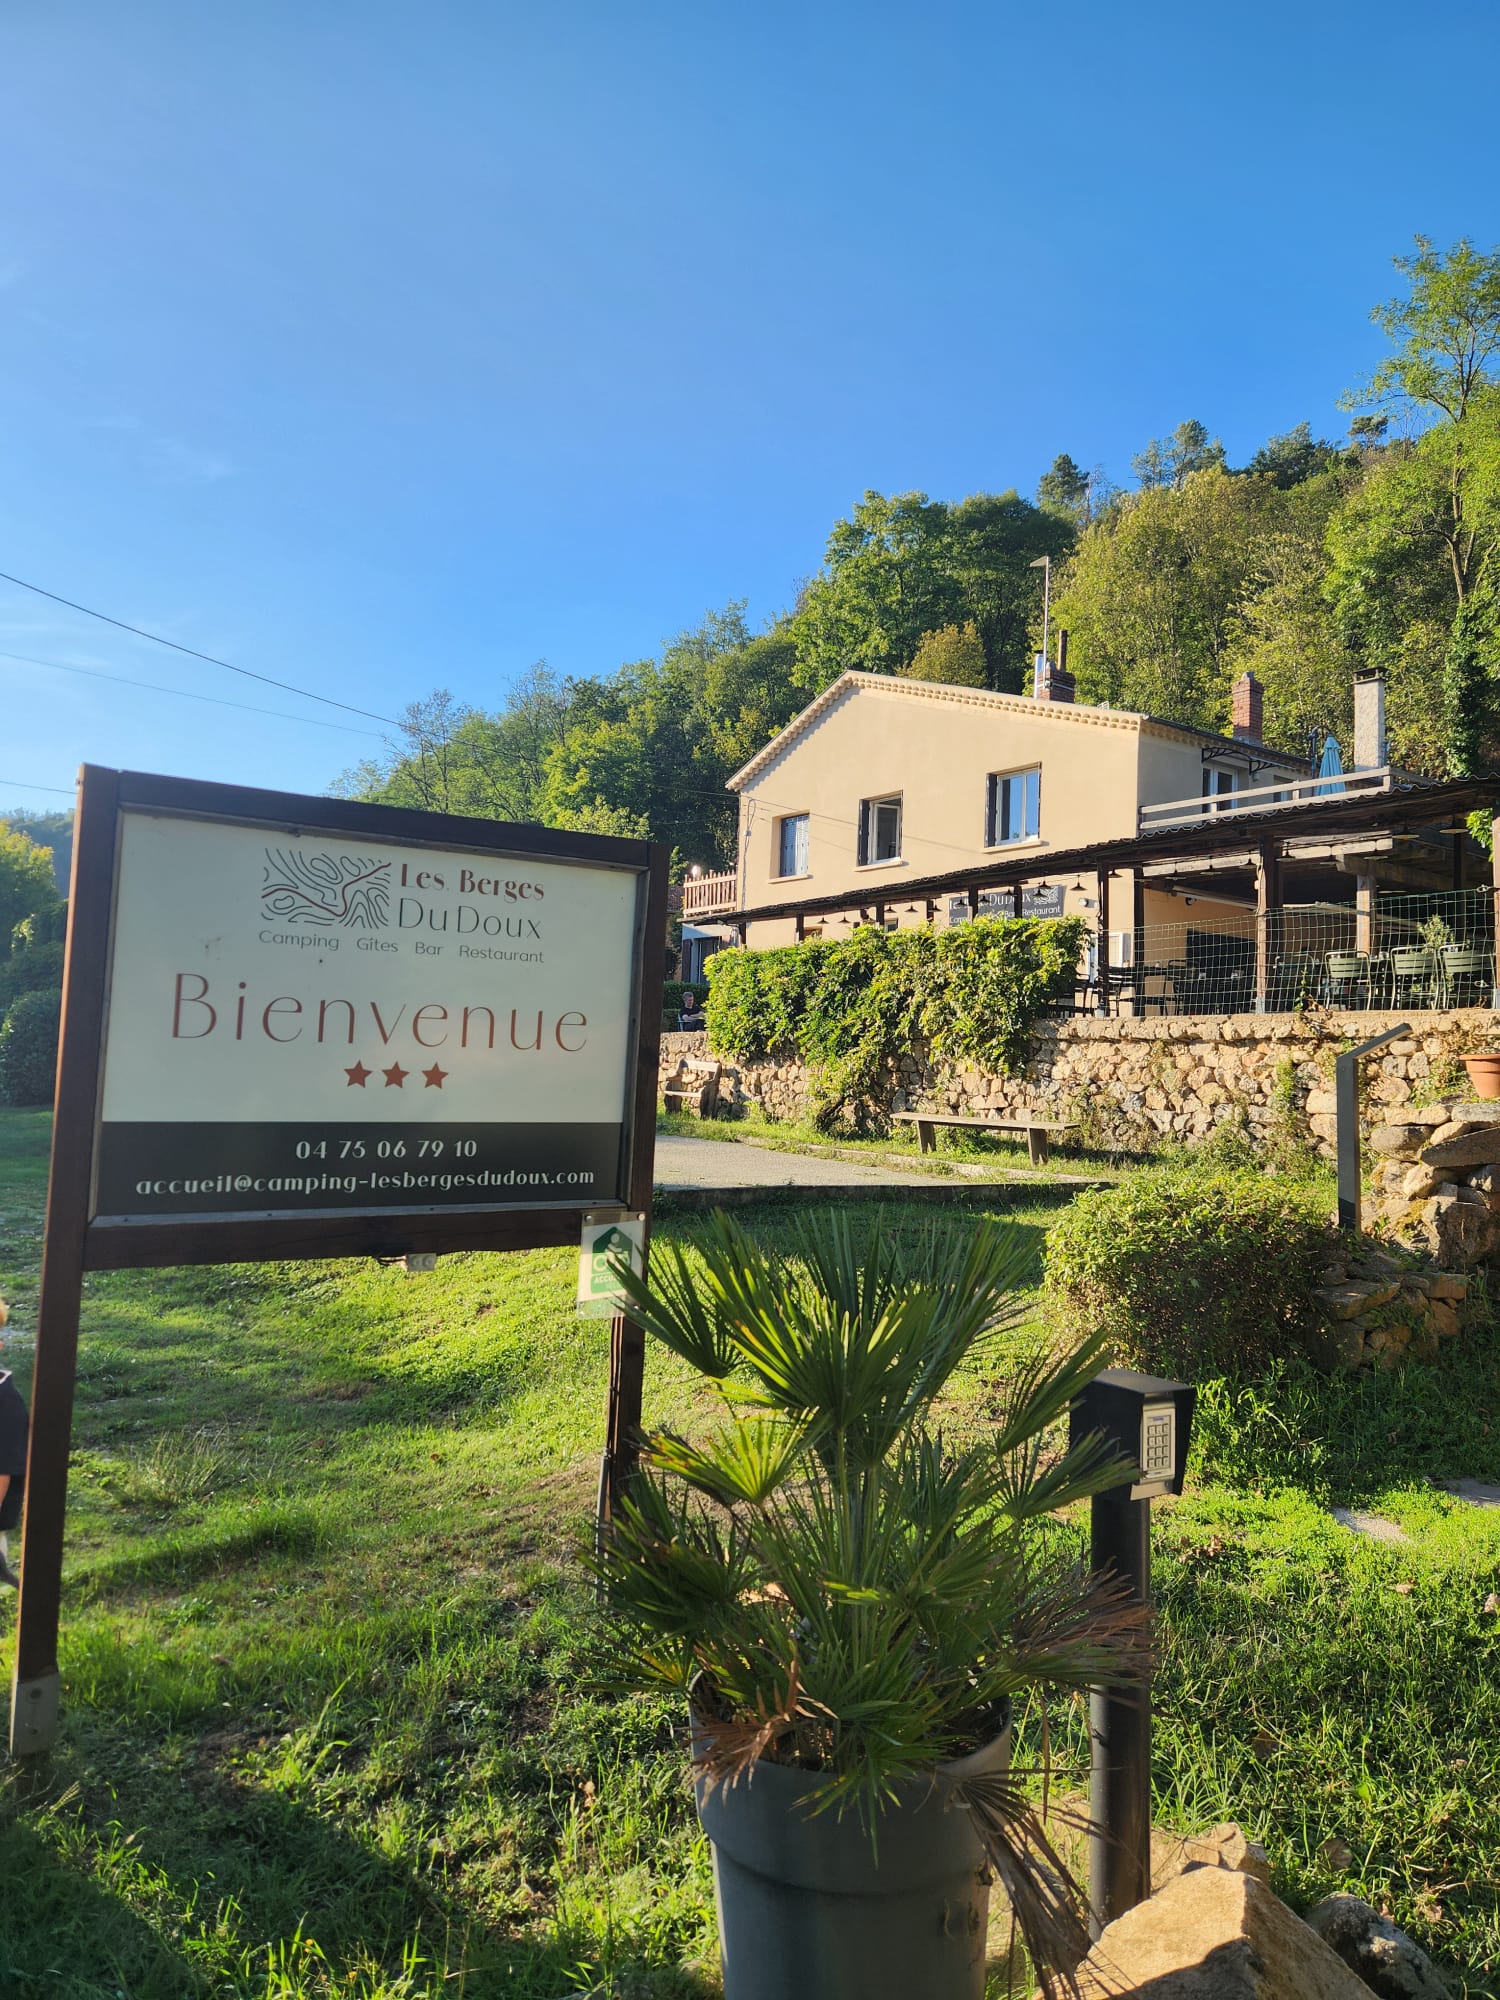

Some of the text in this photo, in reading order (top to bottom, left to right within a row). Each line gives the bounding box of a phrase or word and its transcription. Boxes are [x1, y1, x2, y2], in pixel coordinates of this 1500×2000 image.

[460, 869, 545, 903] Berges
[1022, 905, 1061, 916] Restaurant
[258, 930, 545, 963] Camping Gîtes Bar Restaurant
[172, 973, 588, 1052] Bienvenue
[295, 1139, 477, 1159] 04 75 06 79 10
[135, 1168, 595, 1196] accueil@camping-lesbergesdudoux.com
